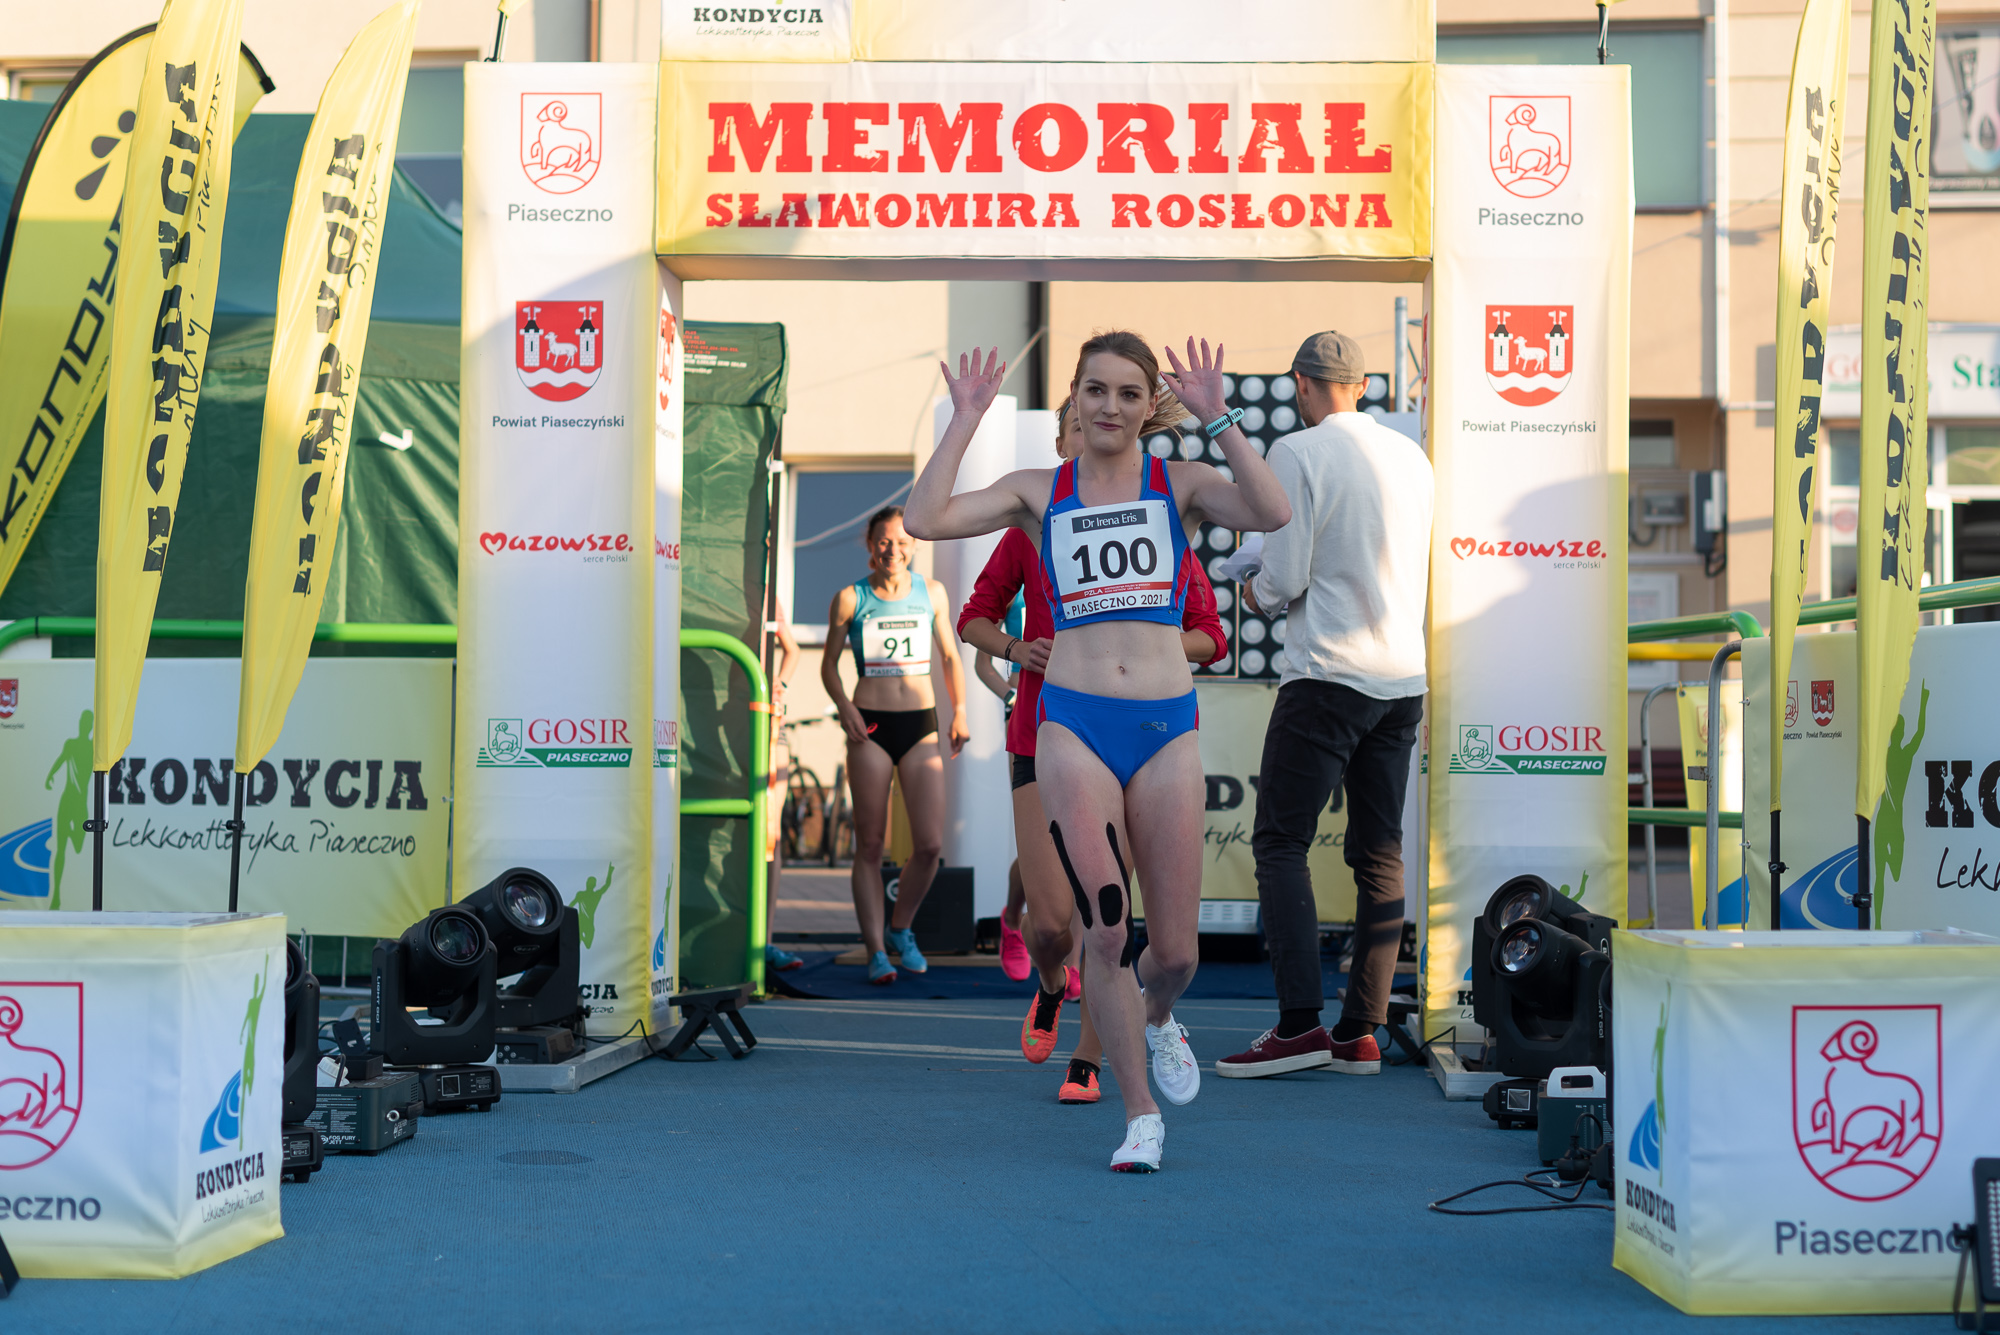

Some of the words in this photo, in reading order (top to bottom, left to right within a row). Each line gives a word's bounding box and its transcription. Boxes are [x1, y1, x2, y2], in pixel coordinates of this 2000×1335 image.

[694, 8, 824, 23] KONDYCJA
[707, 102, 1392, 173] MEMORIAŁ
[507, 204, 614, 222] Piaseczno
[706, 193, 1080, 228] SŁAWOMIRA
[1111, 193, 1393, 228] ROSŁONA
[1478, 208, 1584, 226] Piaseczno
[492, 415, 537, 428] Powiat
[541, 415, 625, 431] Piaseczyński
[1462, 420, 1506, 432] Powiat
[1510, 420, 1596, 436] Piaseczyński
[1082, 519, 1095, 529] Dr
[1096, 515, 1120, 527] Irena
[1121, 513, 1138, 524] Eris
[606, 555, 628, 563] Polski
[1071, 537, 1158, 585] 100
[1553, 561, 1575, 569] serce
[1577, 560, 1601, 569] Polski
[1071, 595, 1137, 616] PIASECZNO
[1140, 594, 1163, 605] 2021
[883, 636, 914, 659] 91
[528, 718, 632, 745] GOSIR
[1498, 725, 1606, 751] GOSIR
[546, 752, 629, 763] PIASECZNO
[1517, 759, 1604, 770] PIASECZNO
[108, 758, 428, 811] KONDYCJA
[196, 1152, 265, 1200] KONDYCJA
